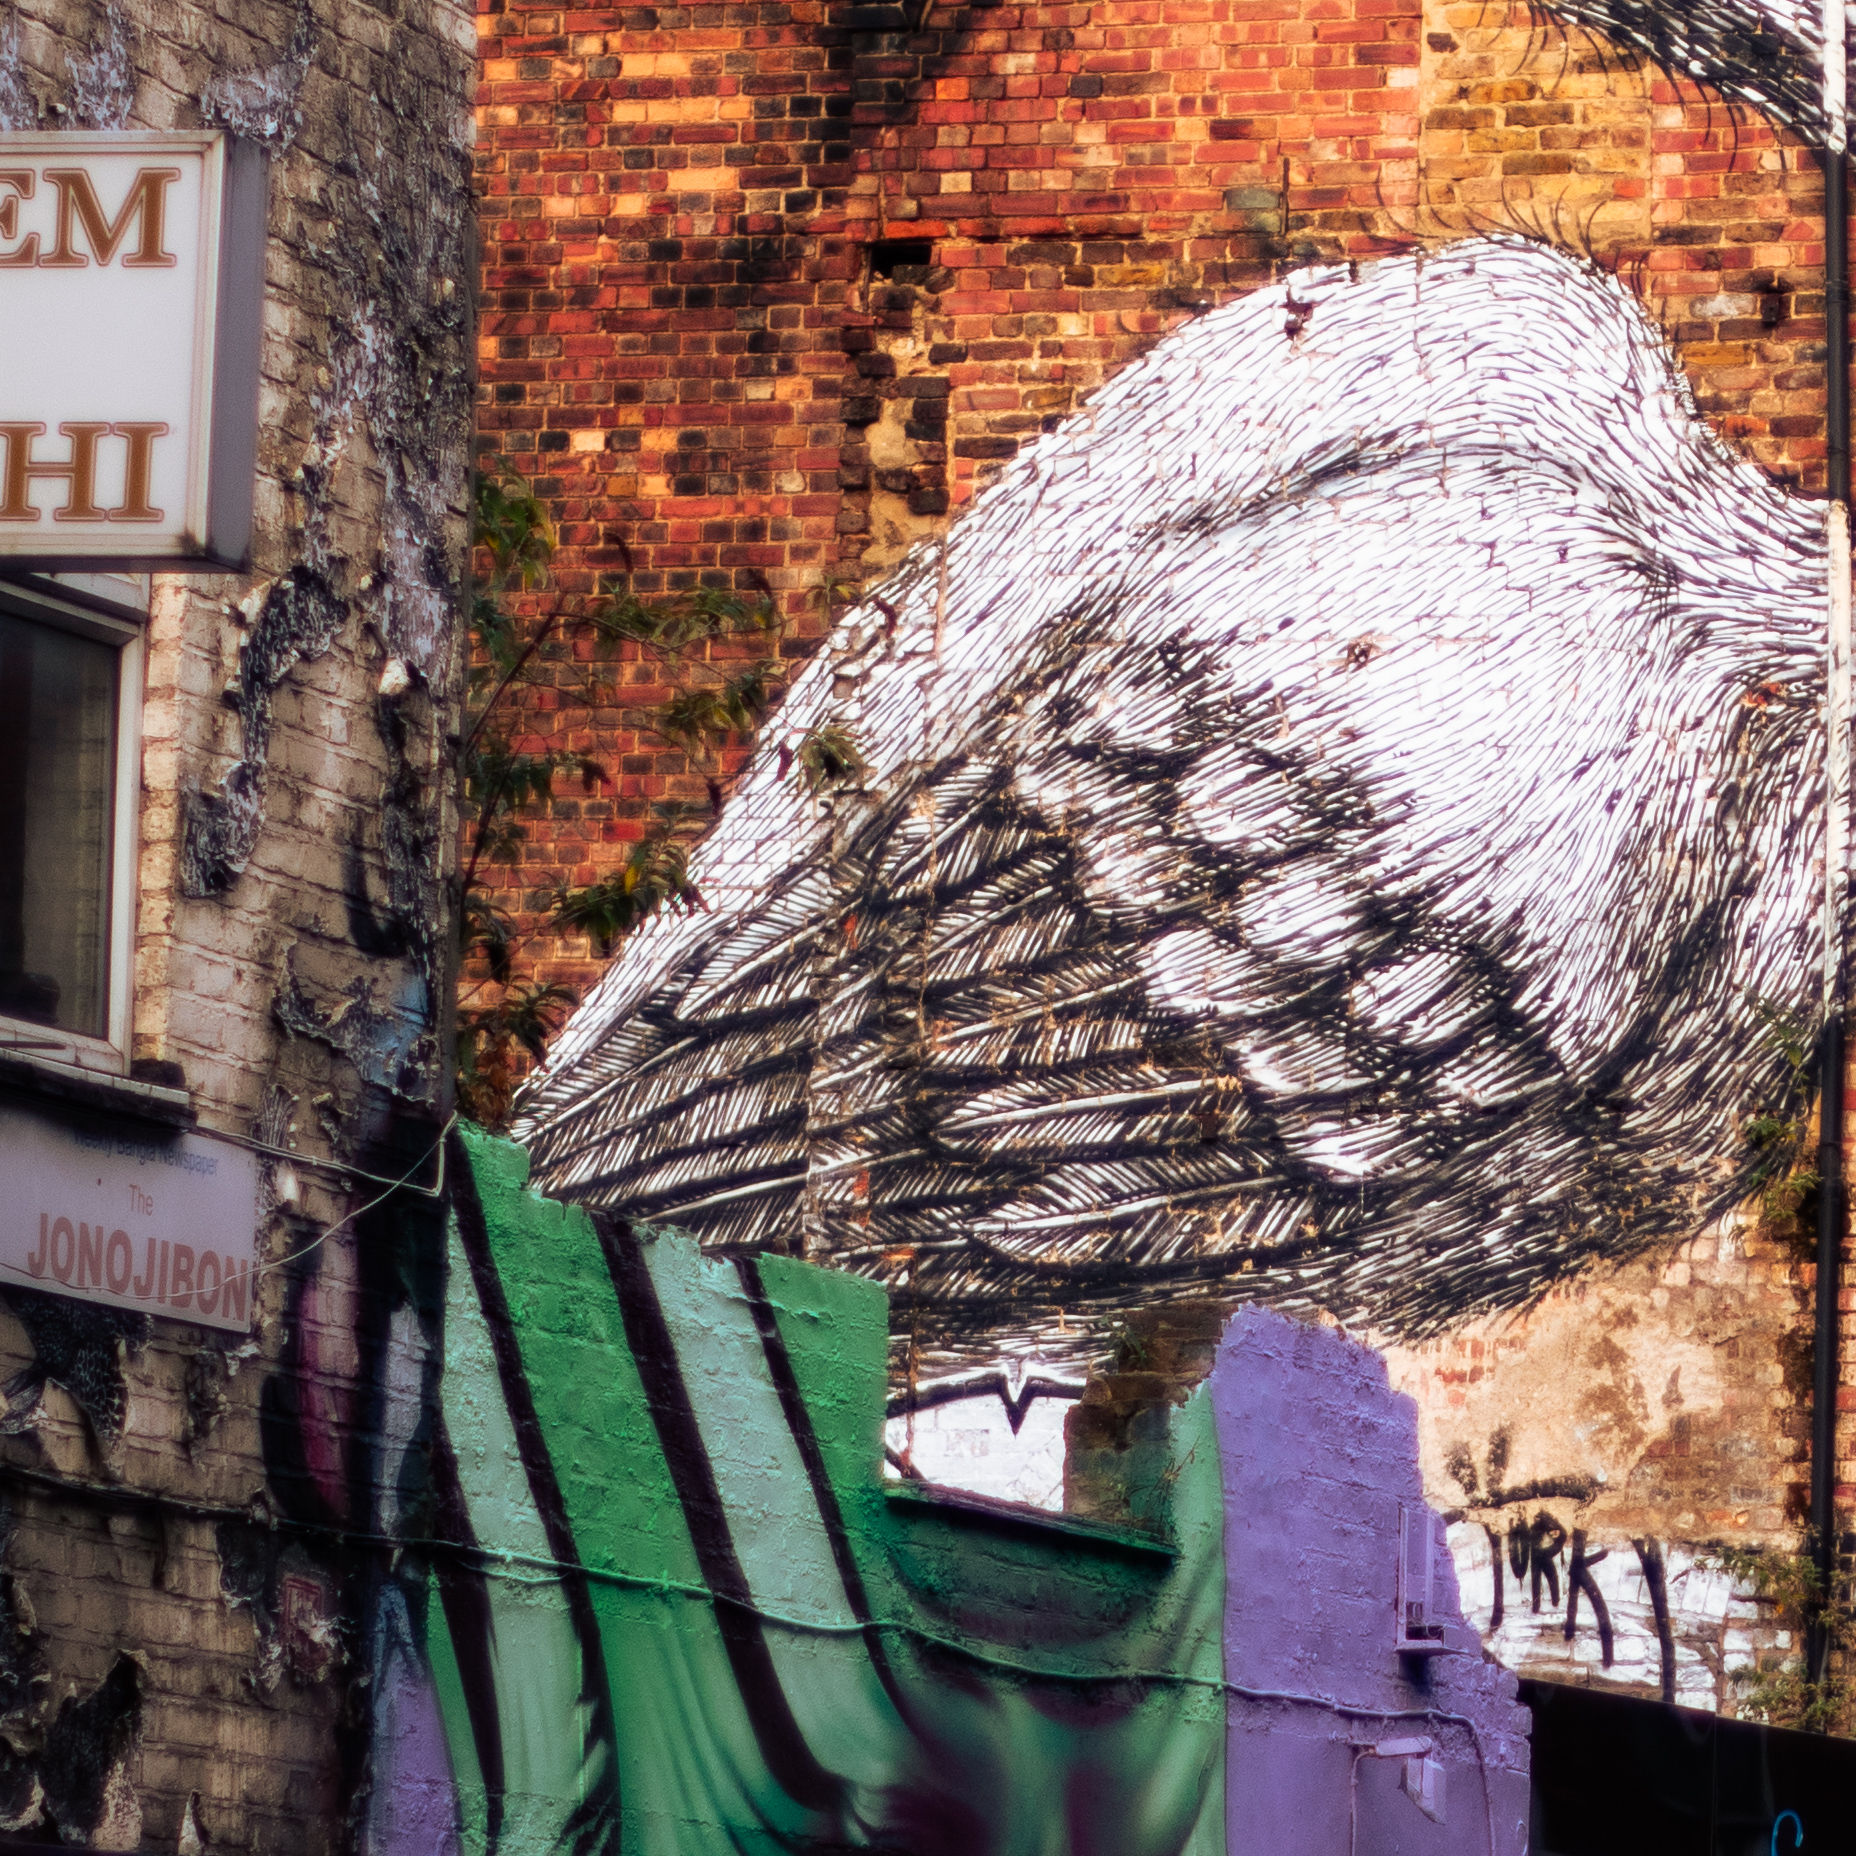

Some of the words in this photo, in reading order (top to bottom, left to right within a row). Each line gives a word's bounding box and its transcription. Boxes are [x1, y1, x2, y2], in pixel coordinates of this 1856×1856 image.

[160, 1143, 218, 1176] Newspaper
[129, 1184, 154, 1216] The
[27, 1212, 249, 1322] JONOJIBON
